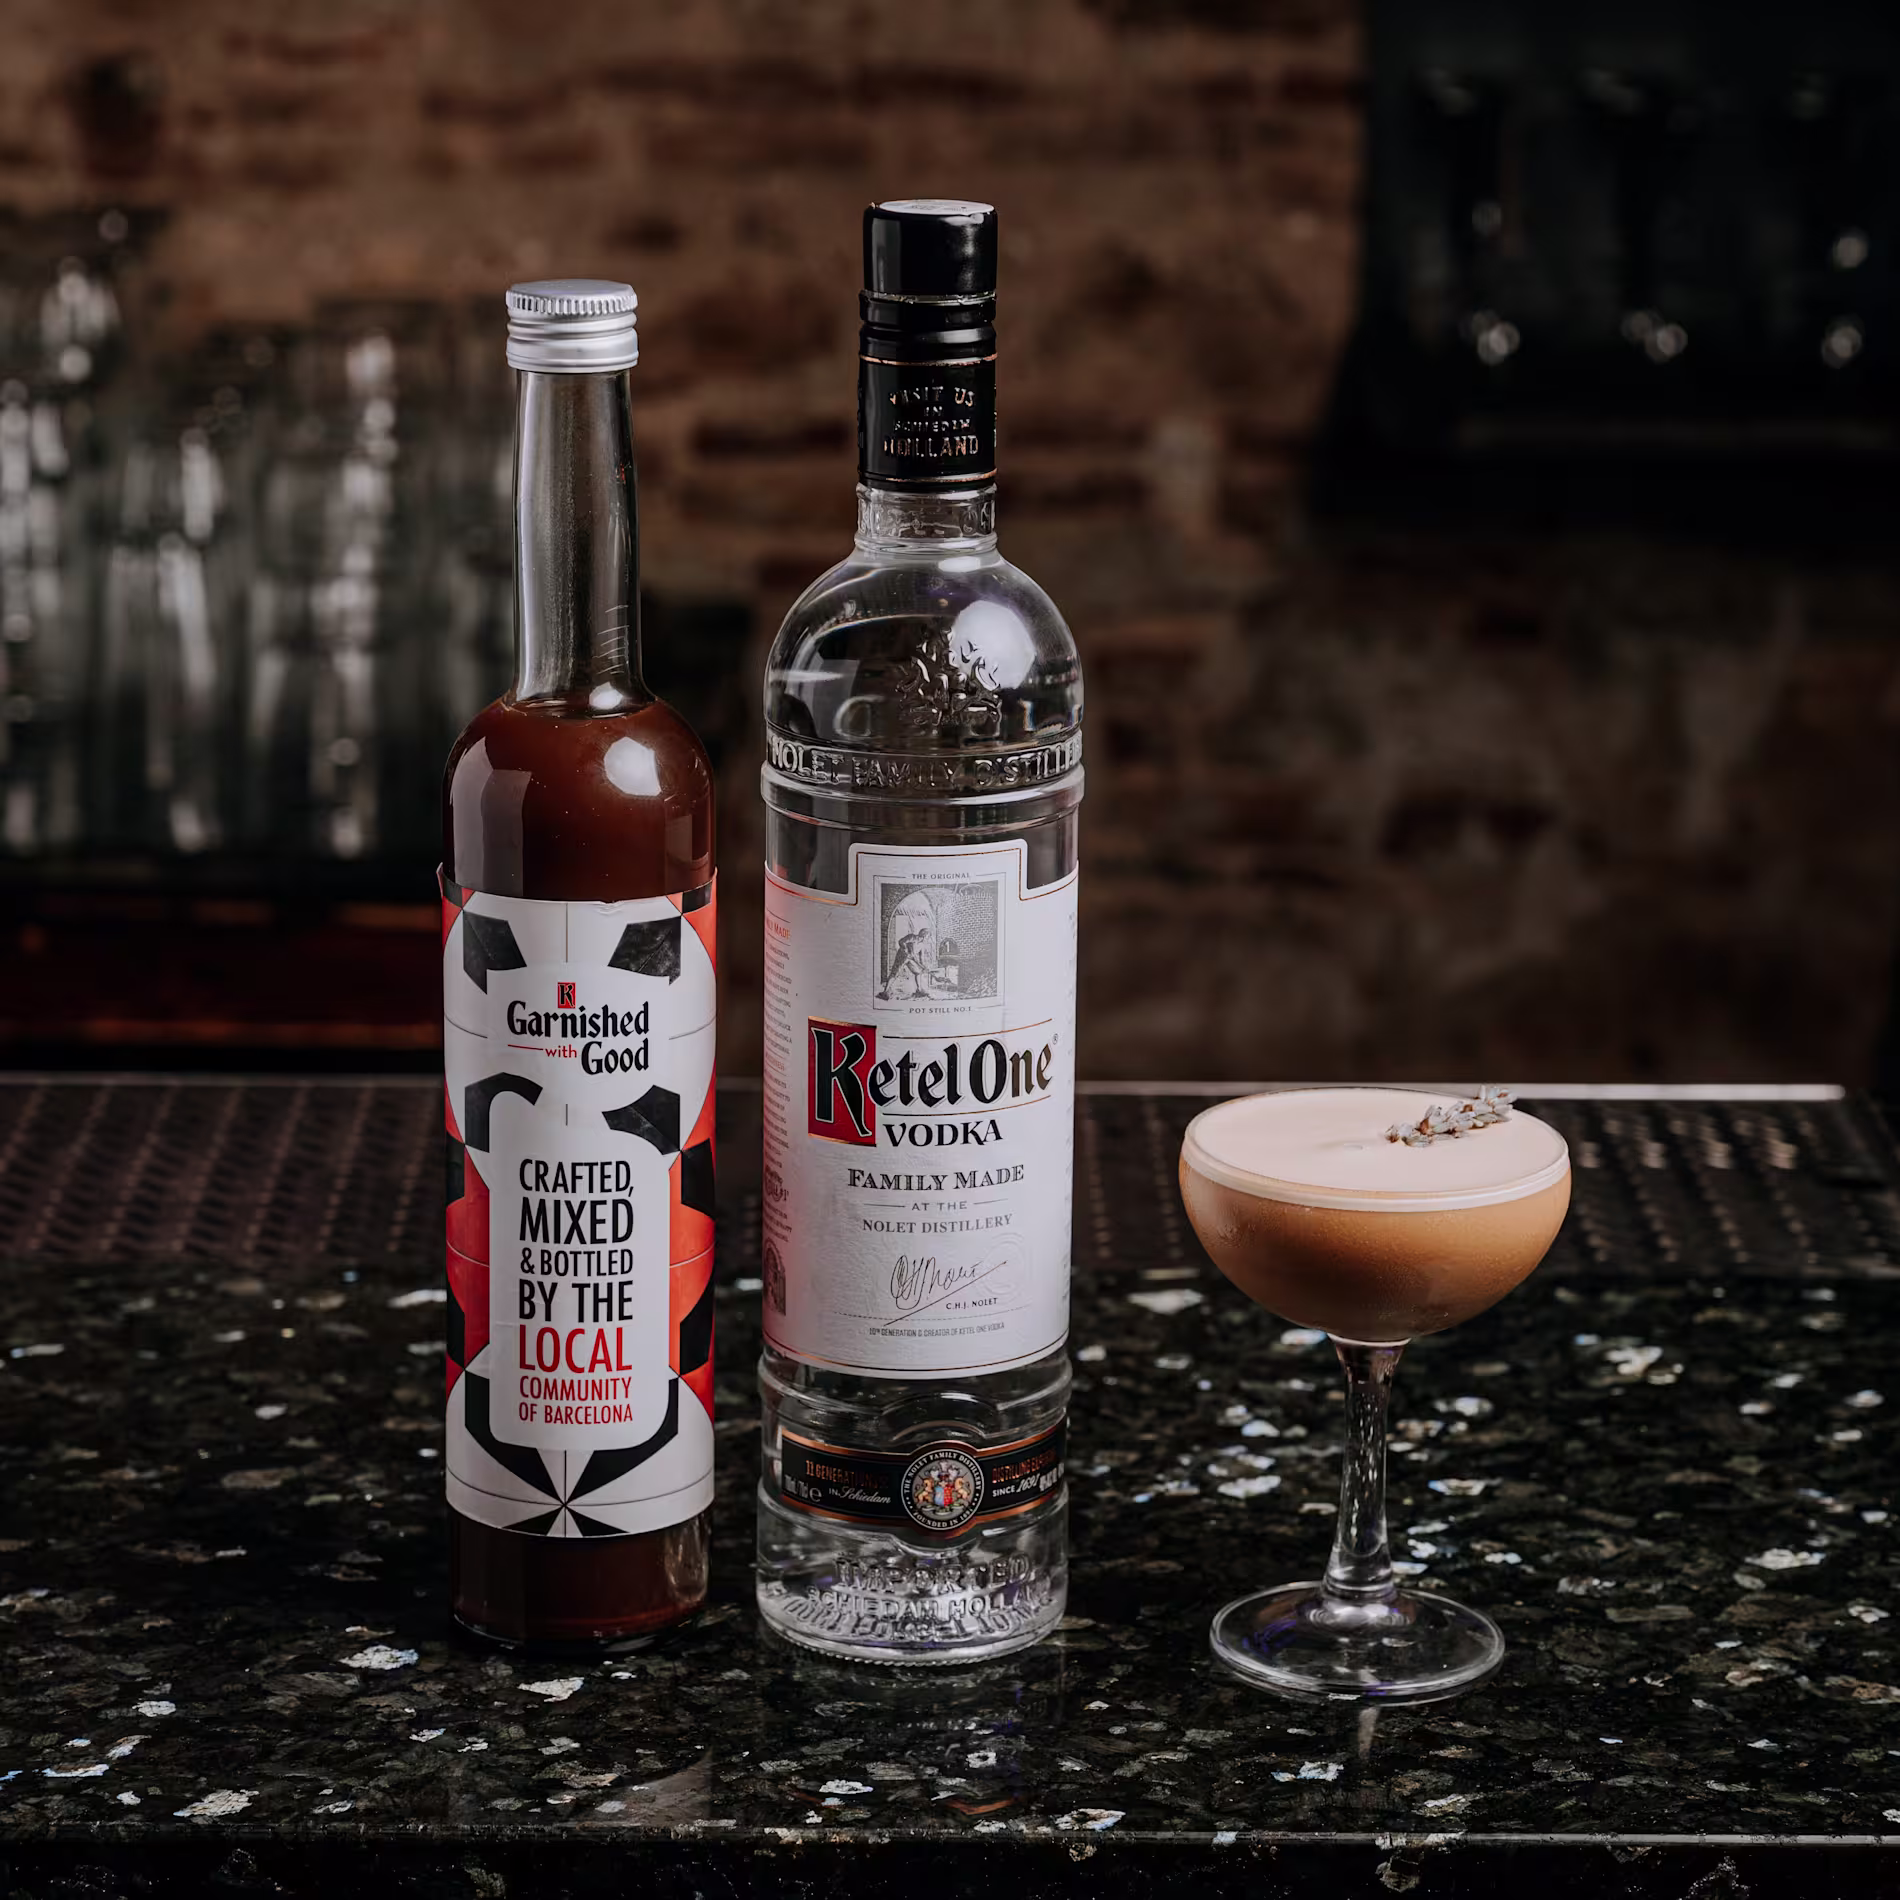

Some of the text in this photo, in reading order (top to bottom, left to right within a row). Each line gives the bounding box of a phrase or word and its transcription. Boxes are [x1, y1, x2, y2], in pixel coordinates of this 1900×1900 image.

[953, 385, 976, 407] US
[930, 872, 970, 880] ORIGINAL
[507, 1000, 649, 1038] Garnished
[545, 1037, 649, 1075] with Good
[811, 1027, 963, 1137] Ketel
[969, 1038, 1053, 1105] One
[882, 1119, 1003, 1147] VODKA
[519, 1158, 634, 1197] CRAFTED,
[847, 1164, 1025, 1192] FAMILY MADE
[911, 1201, 968, 1211] AT THE
[519, 1196, 634, 1245] MIXED
[862, 1213, 1013, 1234] NOLET DISTILLERY
[520, 1247, 634, 1277] & BOTTLED
[519, 1279, 633, 1323] BY THE
[946, 1298, 998, 1310] C.H.J. NOLET
[519, 1324, 633, 1374] LOCAL
[519, 1375, 632, 1401] COMMUNITY
[519, 1403, 633, 1425] OF BARCELONA
[903, 1478, 912, 1495] THE
[908, 1457, 929, 1479] NOLET
[929, 1451, 958, 1461] FAMILY
[958, 1455, 982, 1491] DISTILLERY
[839, 1485, 891, 1505] Schiedam
[992, 1485, 1016, 1498] SINCE
[912, 1511, 949, 1529] FOUNDED
[949, 1518, 960, 1526] IN
